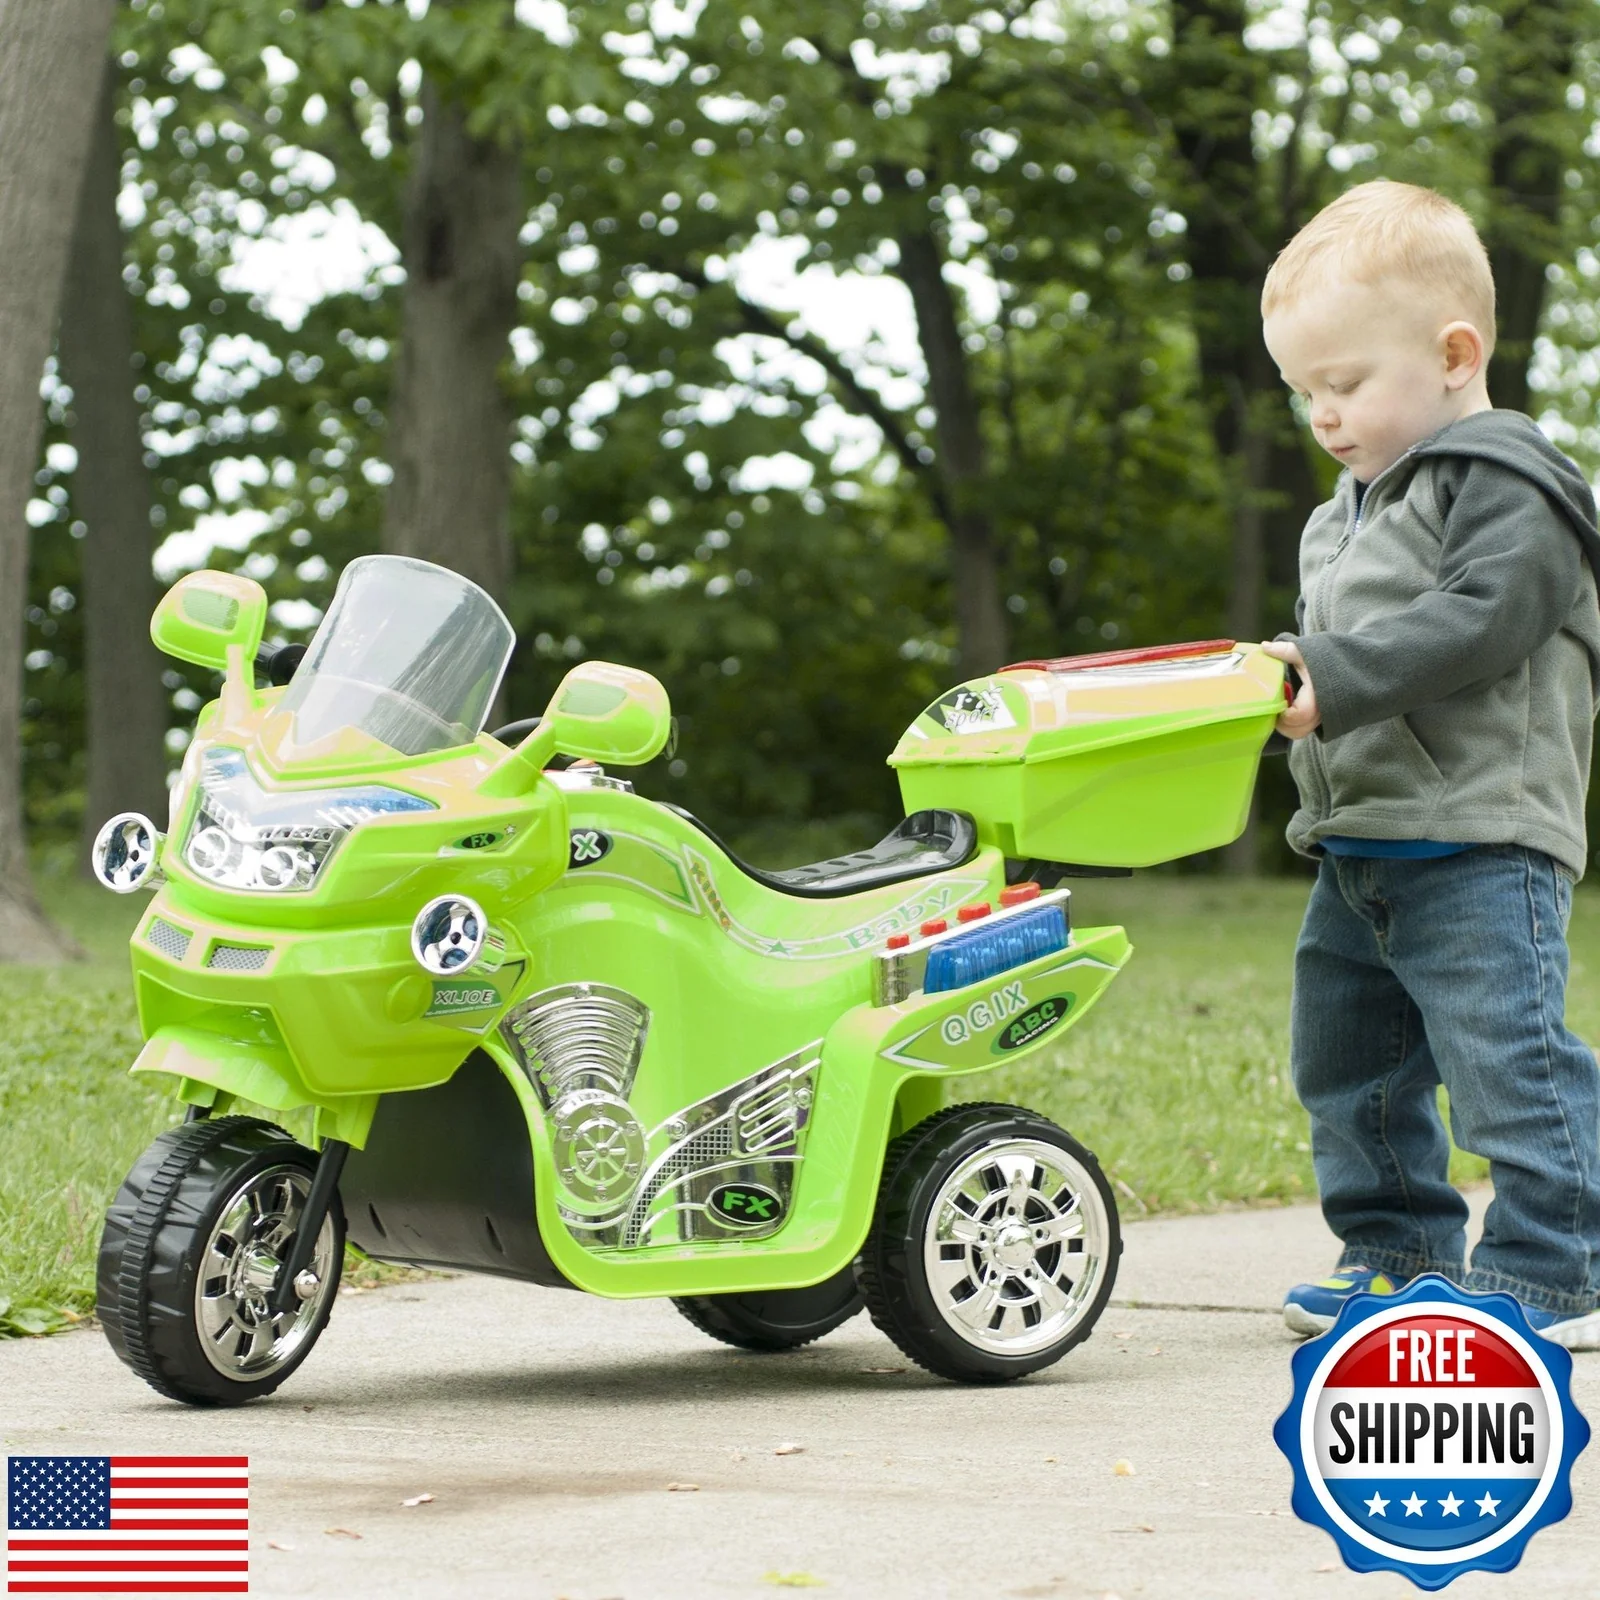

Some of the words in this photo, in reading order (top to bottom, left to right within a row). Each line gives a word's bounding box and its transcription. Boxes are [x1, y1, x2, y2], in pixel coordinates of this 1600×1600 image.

[470, 832, 489, 848] FX
[843, 888, 951, 949] Baby
[434, 989, 496, 1005] XIJOE
[941, 980, 1028, 1045] QGIX
[1009, 1001, 1056, 1043] ABC
[723, 1191, 772, 1218] FX
